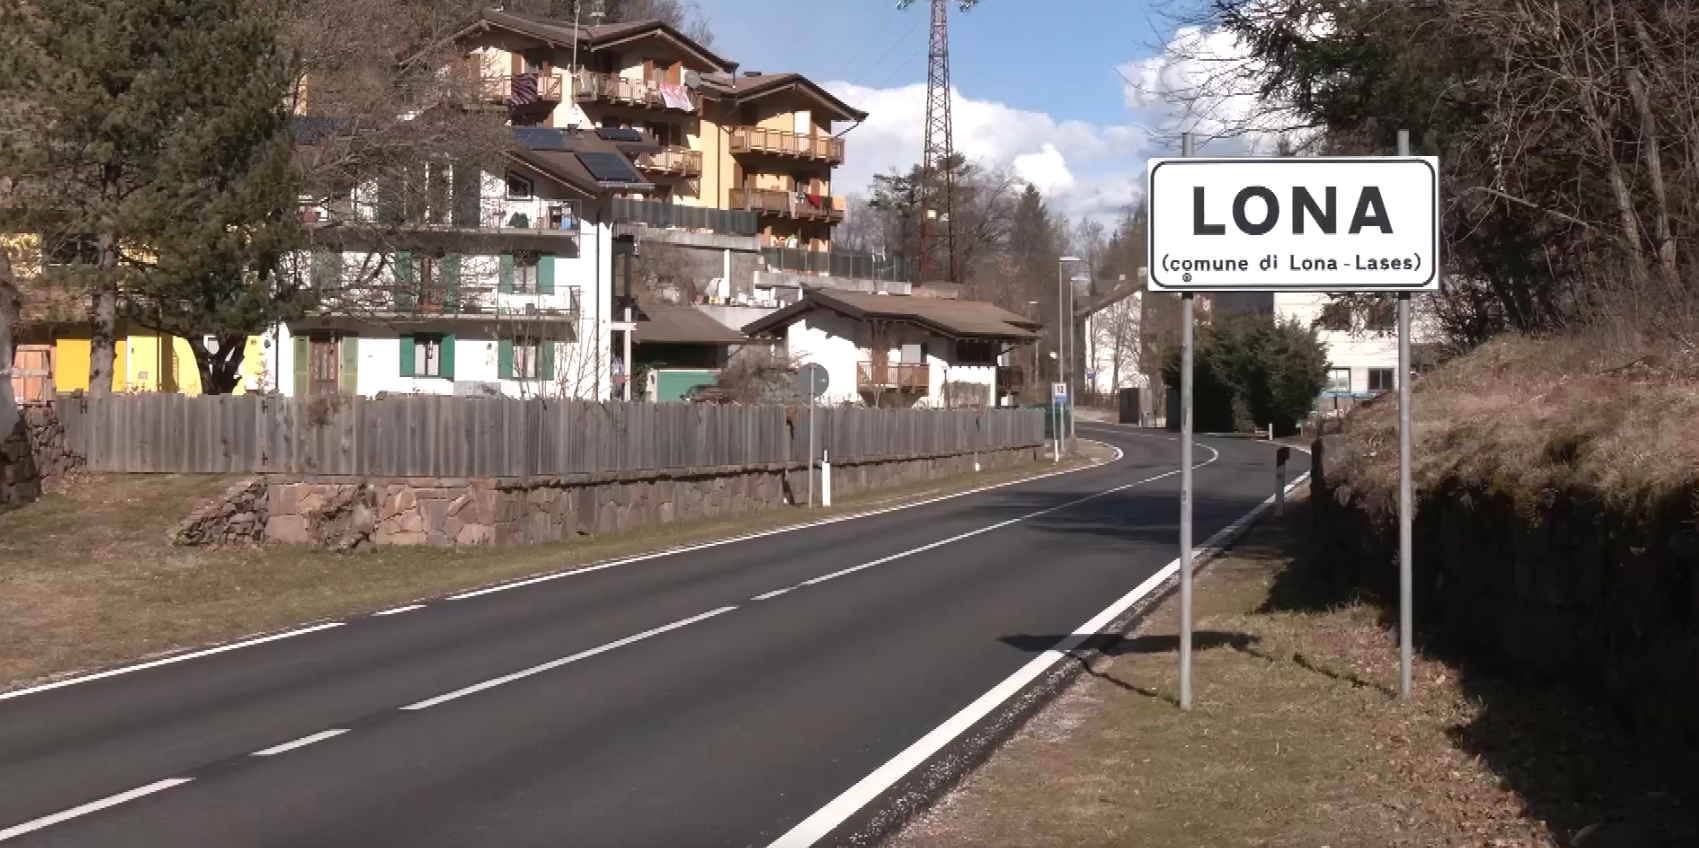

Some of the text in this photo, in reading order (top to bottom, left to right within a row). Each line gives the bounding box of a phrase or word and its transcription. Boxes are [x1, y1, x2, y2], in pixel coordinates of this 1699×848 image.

[1193, 185, 1394, 236] LONA
[1161, 253, 1249, 271] (comune
[1259, 252, 1278, 270] di
[1290, 253, 1338, 271] Lona
[1355, 253, 1421, 271] Lases)
